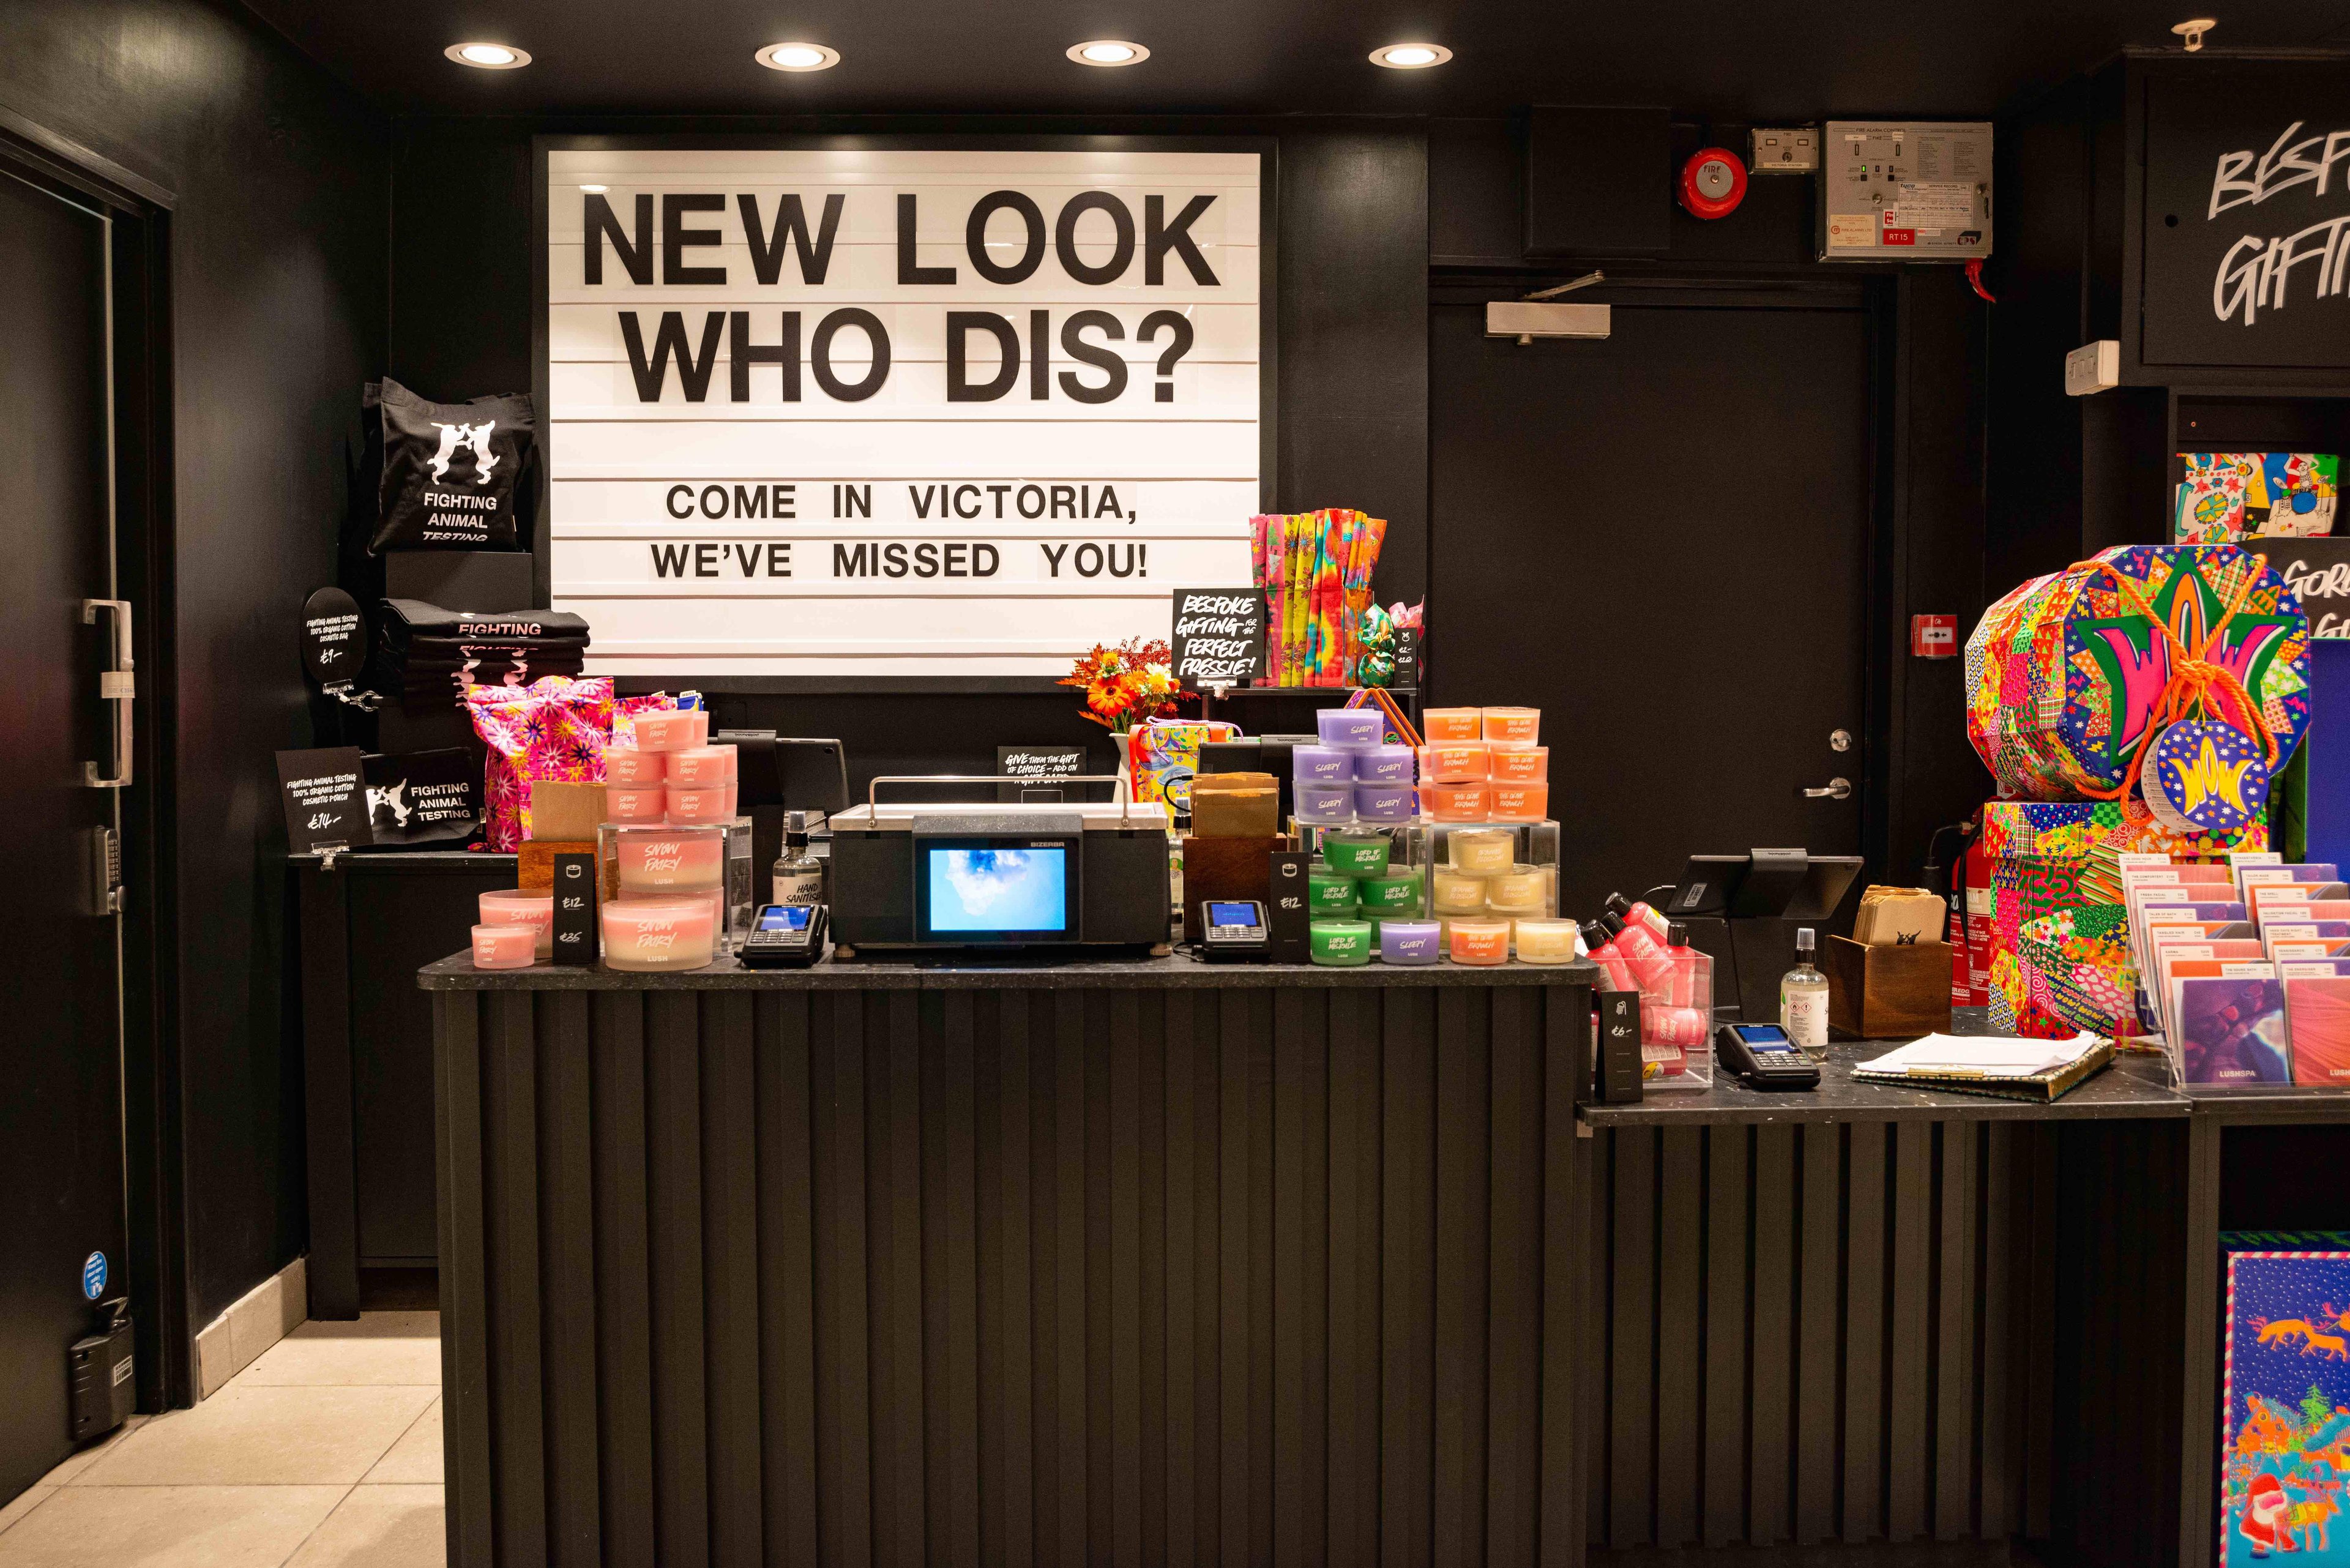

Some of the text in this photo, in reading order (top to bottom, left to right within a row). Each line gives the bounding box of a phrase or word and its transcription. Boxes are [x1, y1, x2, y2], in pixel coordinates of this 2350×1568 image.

[1703, 165, 1721, 174] FIRE
[583, 190, 1222, 286] NEW LOOK
[617, 307, 1193, 404] WHO DIS?
[424, 493, 497, 510] FIGHTING
[665, 484, 1137, 525] COME IN VICTORIA,
[428, 513, 488, 529] ANIMAL
[422, 531, 488, 542] TESTING
[650, 542, 1148, 580] WE'VE MISSED YOU!
[1182, 594, 1256, 614] BESPOKE
[307, 614, 359, 627] FIGHTING ANIMAL TESTING
[323, 625, 341, 634] ORGANIC
[458, 623, 542, 636] FIGHTING
[1175, 617, 1257, 638] GIFTING FOR
[1242, 625, 1256, 634] THE
[319, 632, 349, 643] COSMETIC BAG
[1185, 638, 1253, 658] PERFECT
[1179, 657, 1256, 676] PRESSIE!
[1351, 724, 1375, 734] SLEEPY
[1005, 753, 1029, 766] GIVE
[1059, 753, 1080, 764] GIFT
[1017, 764, 1047, 774] CHOICE
[1315, 761, 1341, 772] SLEEPY
[1377, 761, 1403, 773] SLEEPY
[287, 774, 357, 790] FIGHTING ANIMAL TESTING
[2168, 736, 2255, 816] WOW
[293, 783, 354, 797] 100% ORGANIC COTTON
[411, 783, 469, 797] FIGHTING
[302, 793, 348, 806] COSMETIC POUCH
[419, 797, 466, 808] ANIMAL
[1318, 797, 1343, 808] SLEEPY
[1376, 797, 1401, 808] SLEEPY
[417, 810, 471, 821] TESTING
[644, 843, 680, 857] SNOW
[644, 856, 682, 872] FAIRY
[1355, 854, 1381, 862] MISRULE
[796, 884, 818, 894] HAND
[1322, 890, 1349, 899] MISRULE
[1384, 890, 1410, 900] MISRULE
[511, 908, 546, 920] SNOW
[637, 920, 674, 933] SNOW
[636, 931, 677, 949] FAIRY
[1329, 941, 1357, 950] MISRULE
[1400, 938, 1427, 949] SLEEPY
